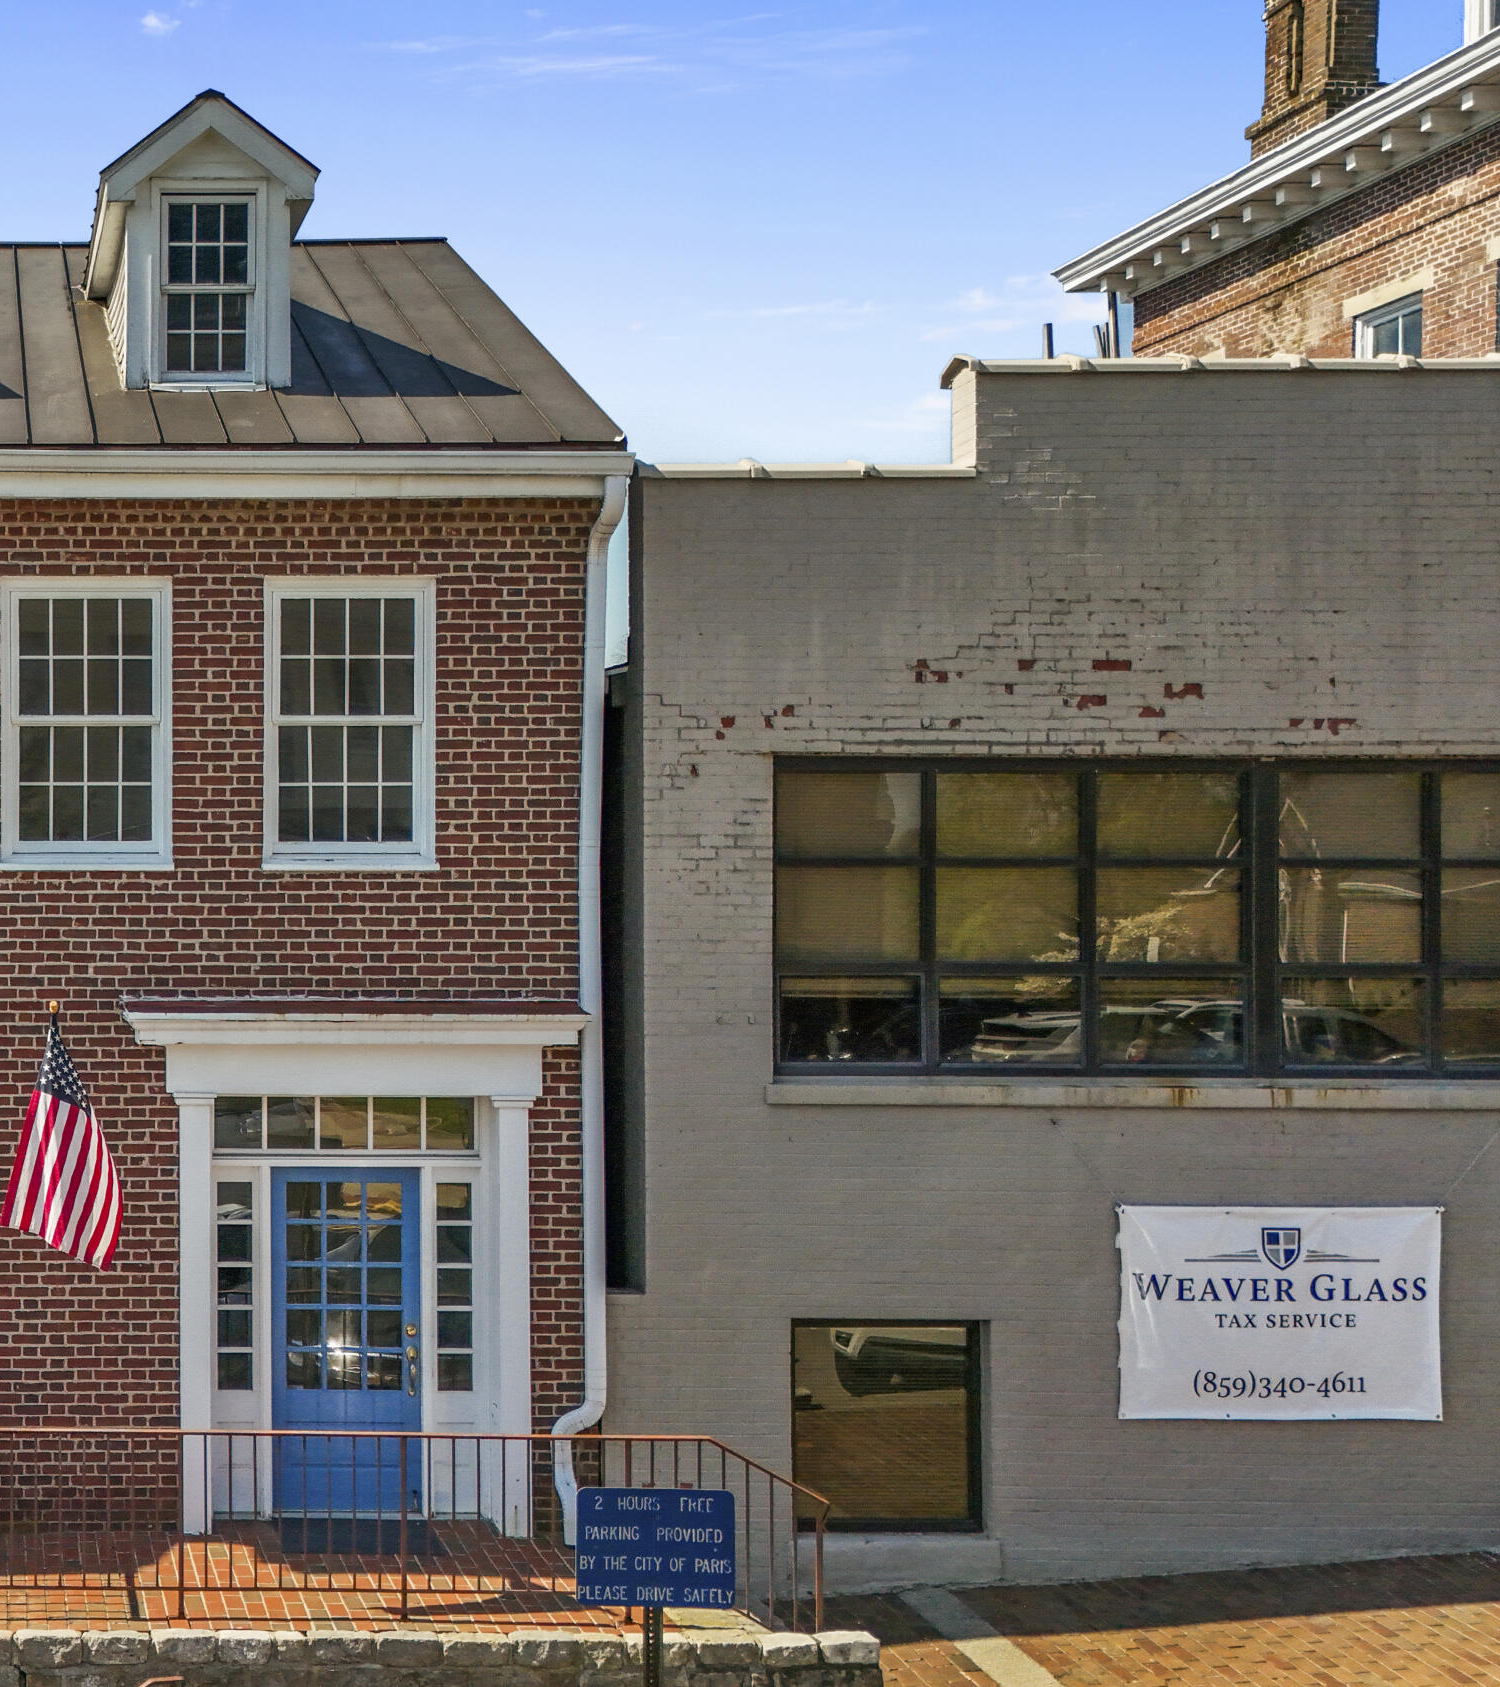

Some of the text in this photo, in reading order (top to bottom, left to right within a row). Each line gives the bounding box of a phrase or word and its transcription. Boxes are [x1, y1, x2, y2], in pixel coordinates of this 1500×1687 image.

[1132, 1272, 1427, 1302] WEAVER GLASS
[1215, 1313, 1357, 1329] TAX SERVICE
[1193, 1369, 1367, 1399] (859)340-4611
[594, 1495, 714, 1513] 2 HOURS FREE
[585, 1526, 723, 1544] PARKING PROVIDED
[579, 1556, 732, 1574] BY THE CITY OF PARIS
[577, 1586, 734, 1604] PLEASE DRIVE SAFELY
